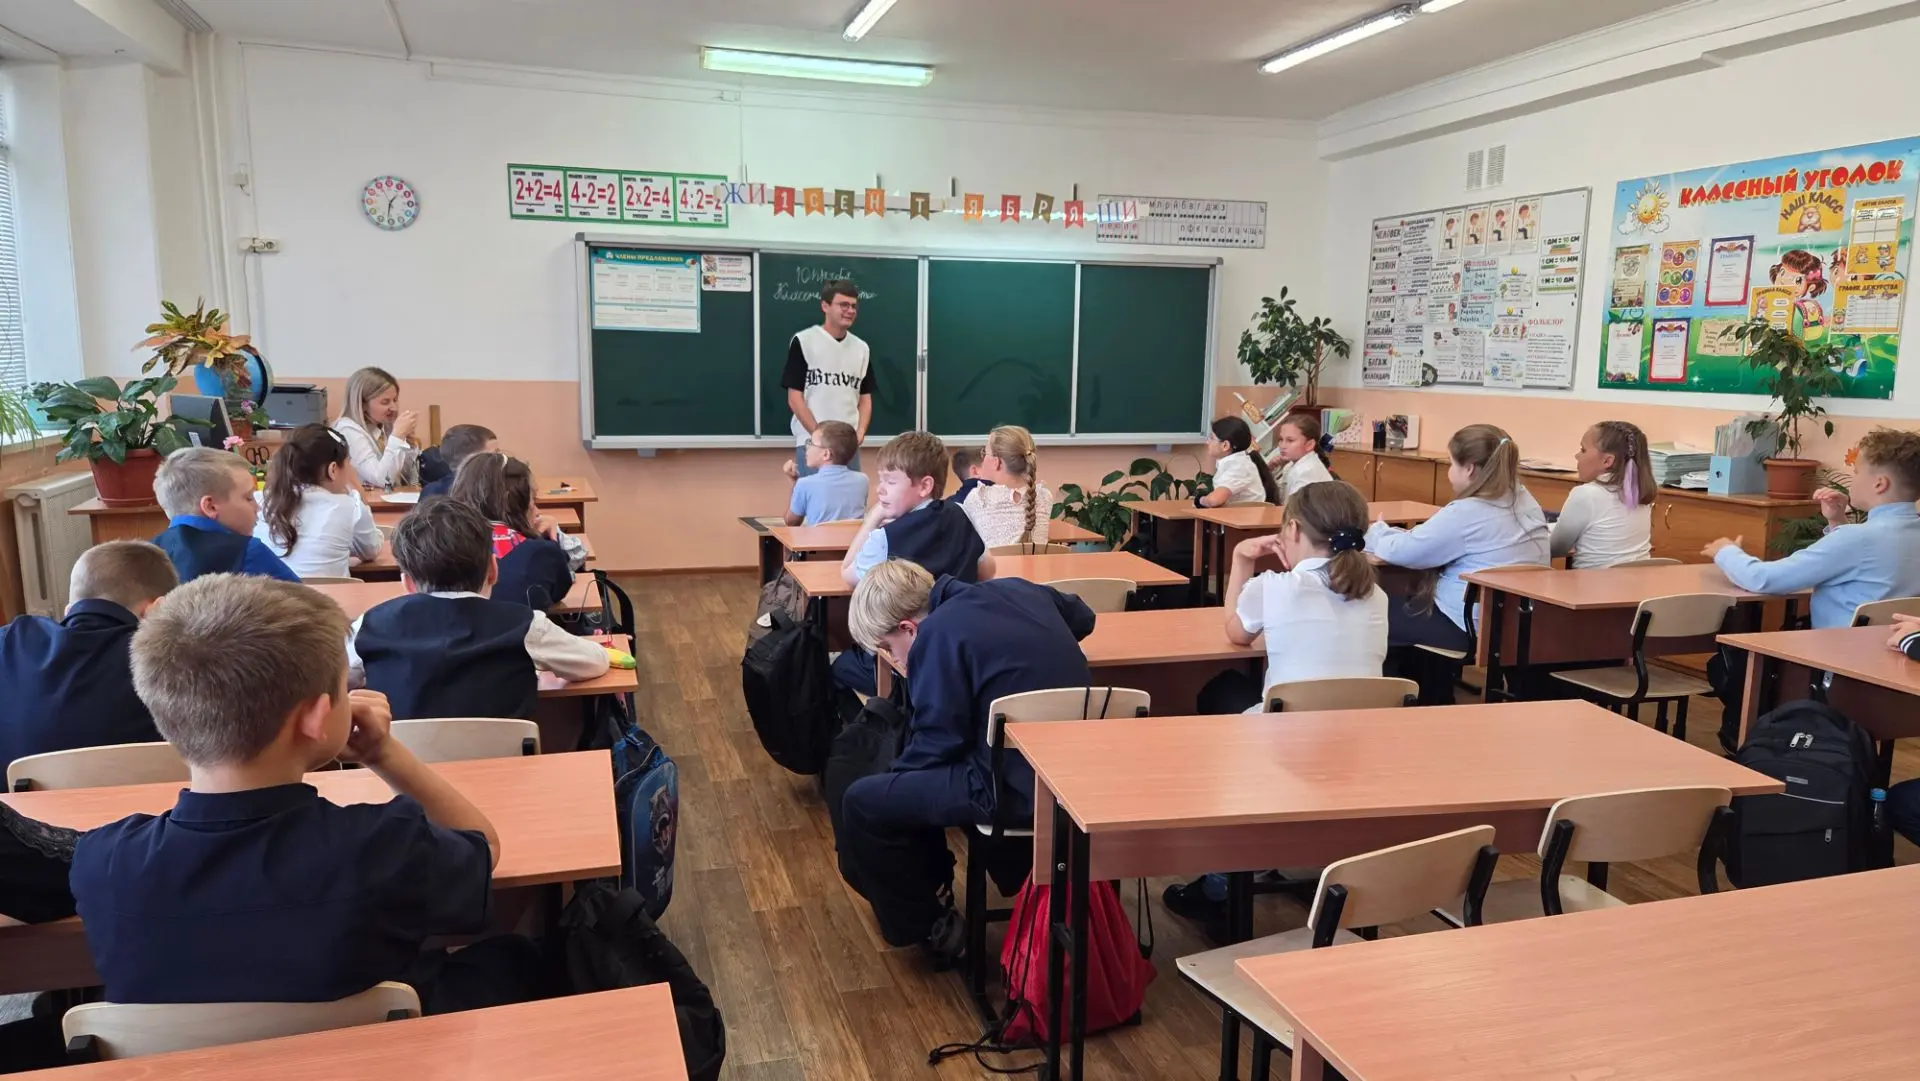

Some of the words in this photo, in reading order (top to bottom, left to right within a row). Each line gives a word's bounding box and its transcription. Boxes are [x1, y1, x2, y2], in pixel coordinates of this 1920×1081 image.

[515, 177, 562, 203] 2+2=4
[571, 180, 616, 205] 4-2=2
[1679, 167, 1798, 206] КЛАССНЫЙ
[1803, 160, 1904, 191] УГОЛОК
[781, 191, 788, 208] 1
[1780, 194, 1806, 220] НАШ
[1809, 191, 1844, 214] КЛАСС
